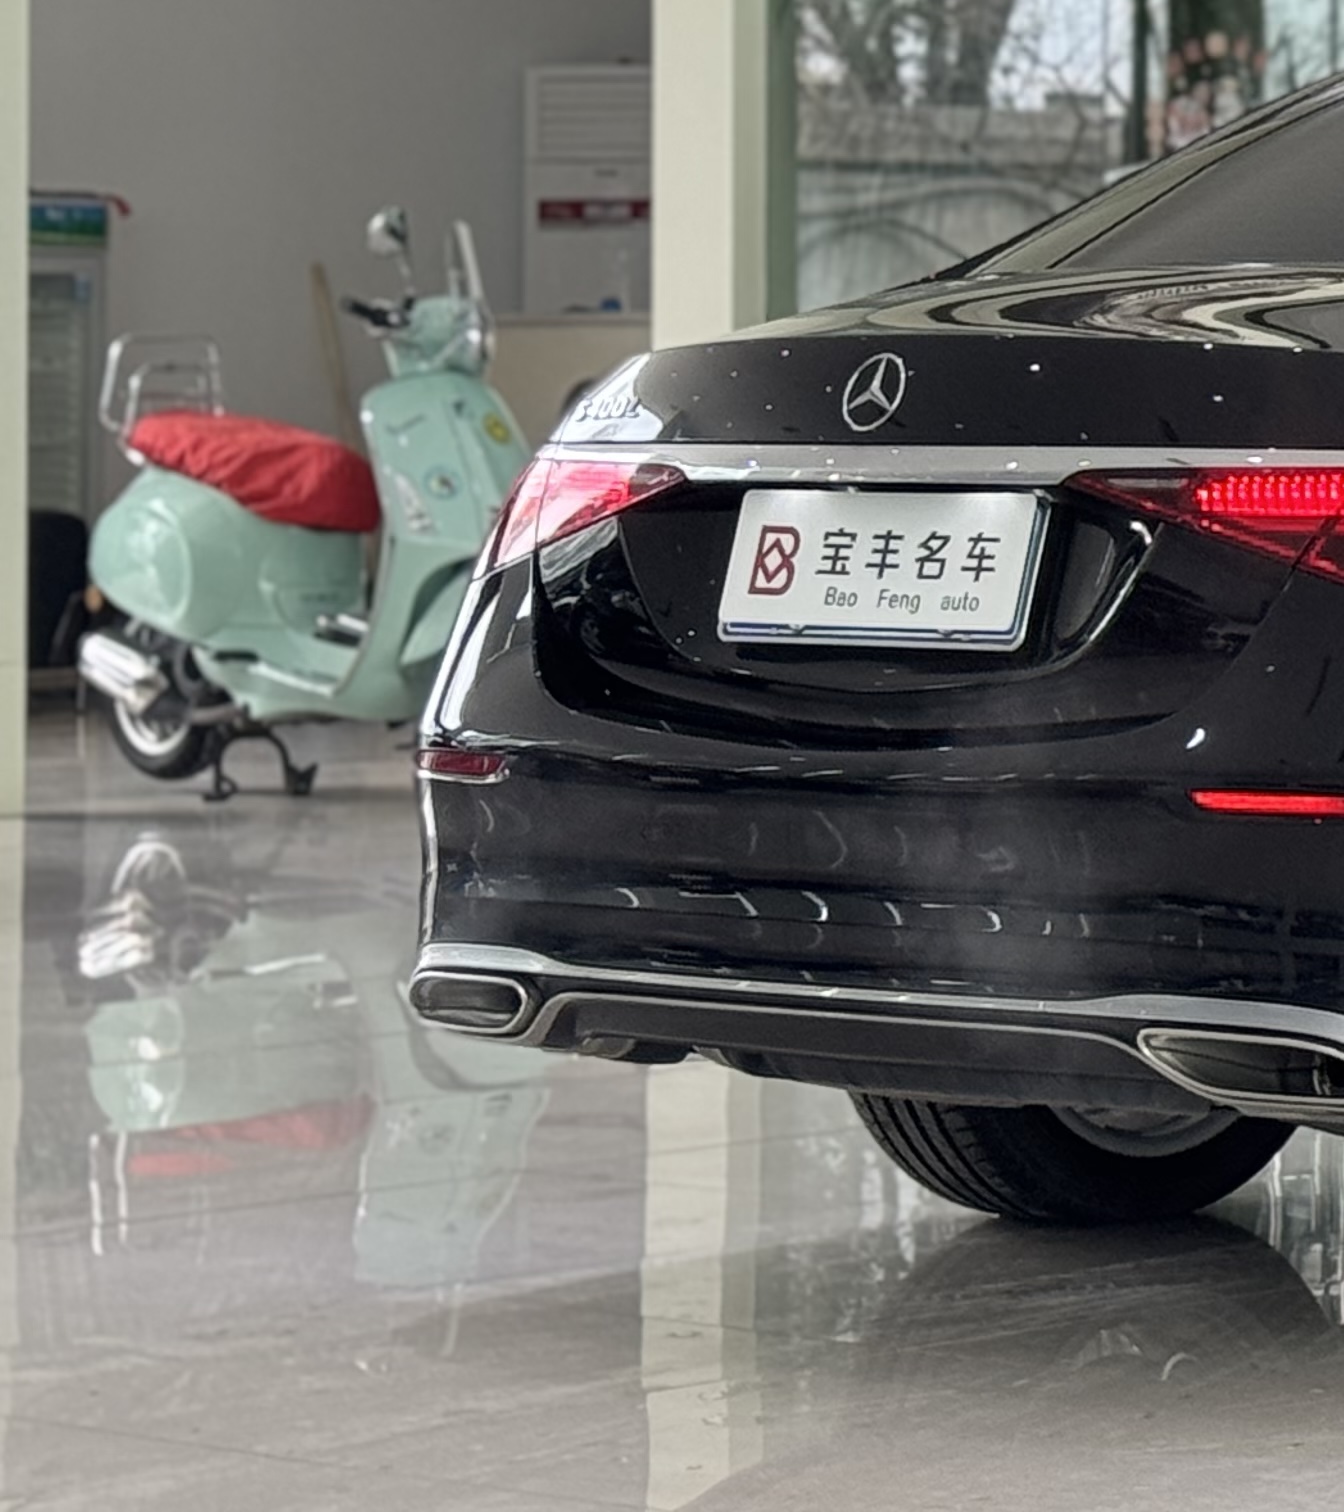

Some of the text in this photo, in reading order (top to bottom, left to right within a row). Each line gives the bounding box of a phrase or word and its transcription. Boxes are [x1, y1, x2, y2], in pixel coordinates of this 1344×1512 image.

[814, 528, 1001, 582] 宝丰名车
[824, 586, 980, 614] Bao Feng auto
